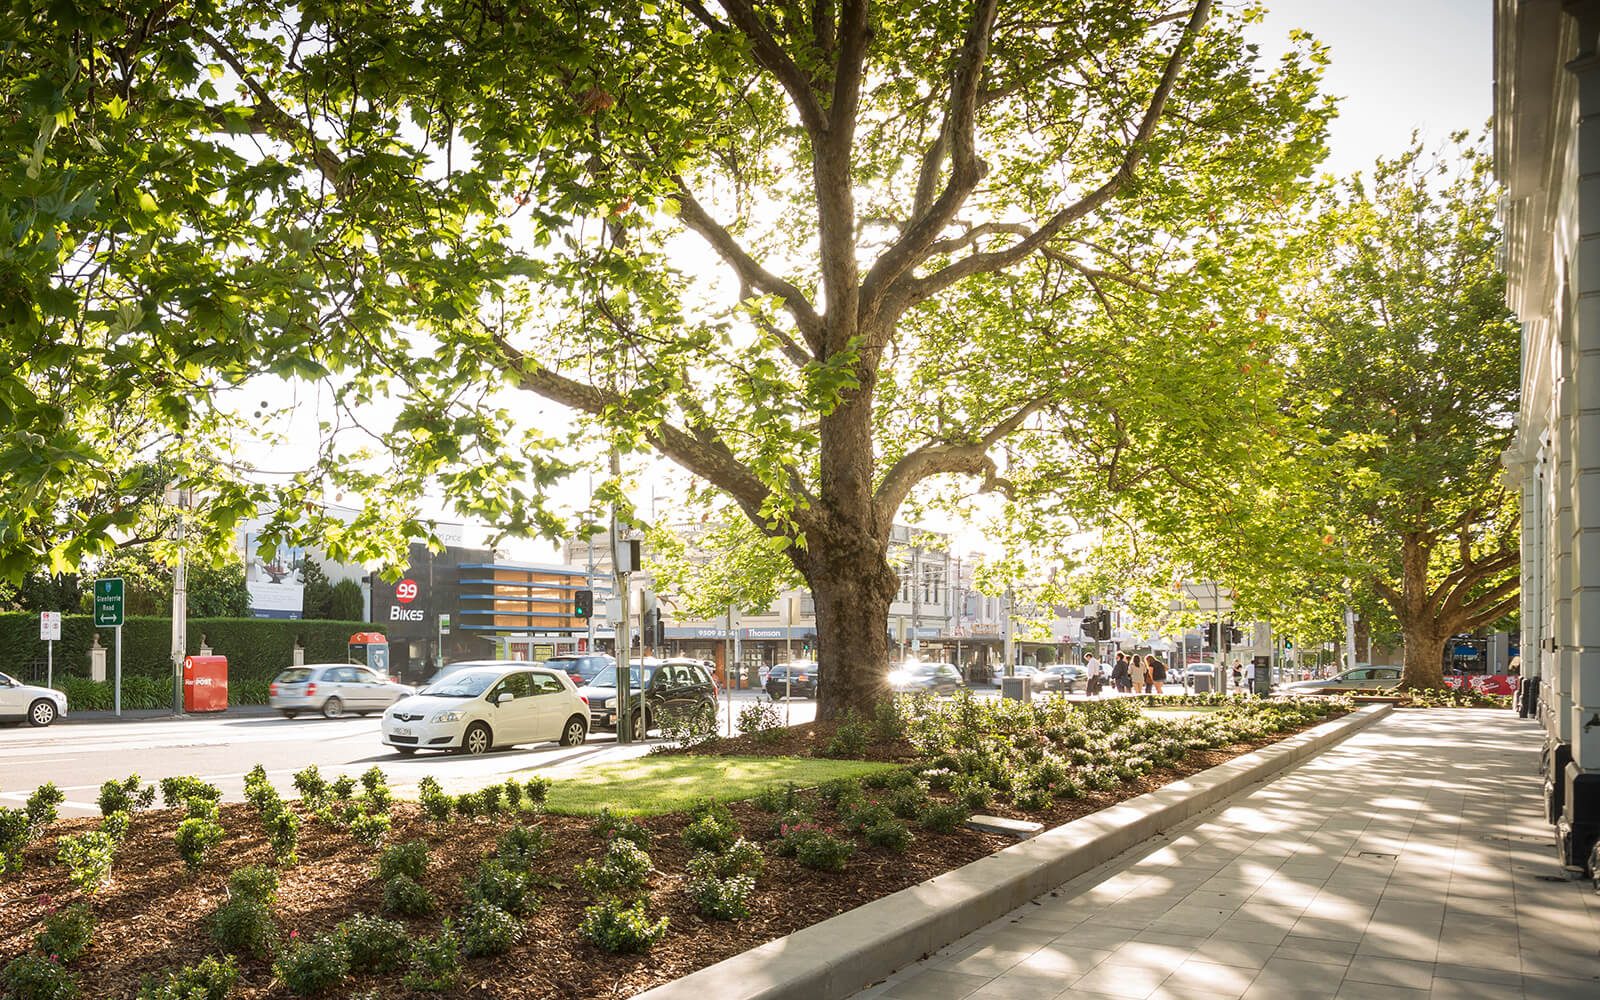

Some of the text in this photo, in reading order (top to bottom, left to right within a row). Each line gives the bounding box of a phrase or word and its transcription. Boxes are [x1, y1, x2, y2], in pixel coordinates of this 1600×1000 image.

[396, 583, 417, 598] 99
[390, 605, 424, 621] Bikes
[748, 628, 781, 637] Thomson
